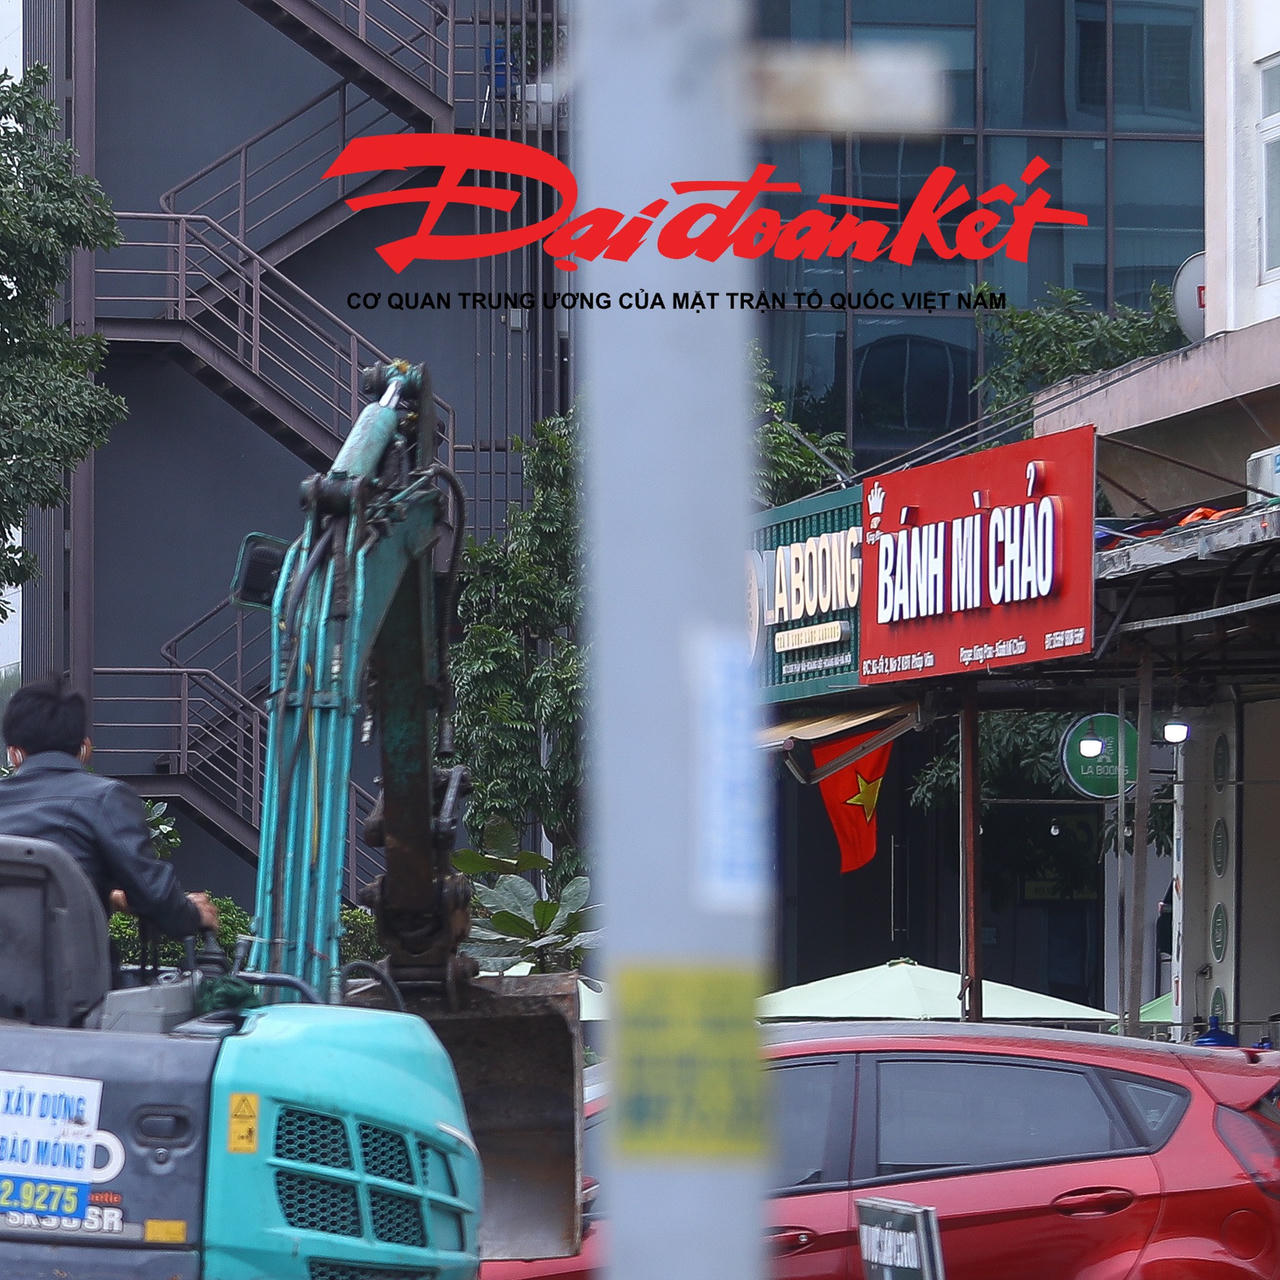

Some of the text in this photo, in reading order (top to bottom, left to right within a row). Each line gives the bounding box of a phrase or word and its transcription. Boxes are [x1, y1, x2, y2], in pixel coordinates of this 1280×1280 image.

[791, 527, 861, 620] BOONG
[877, 461, 1056, 624] BÁNH MÌ CHẢO
[4, 1085, 34, 1117] XÂY
[38, 1092, 87, 1127] DỰNG
[36, 1136, 86, 1170] MÓNG
